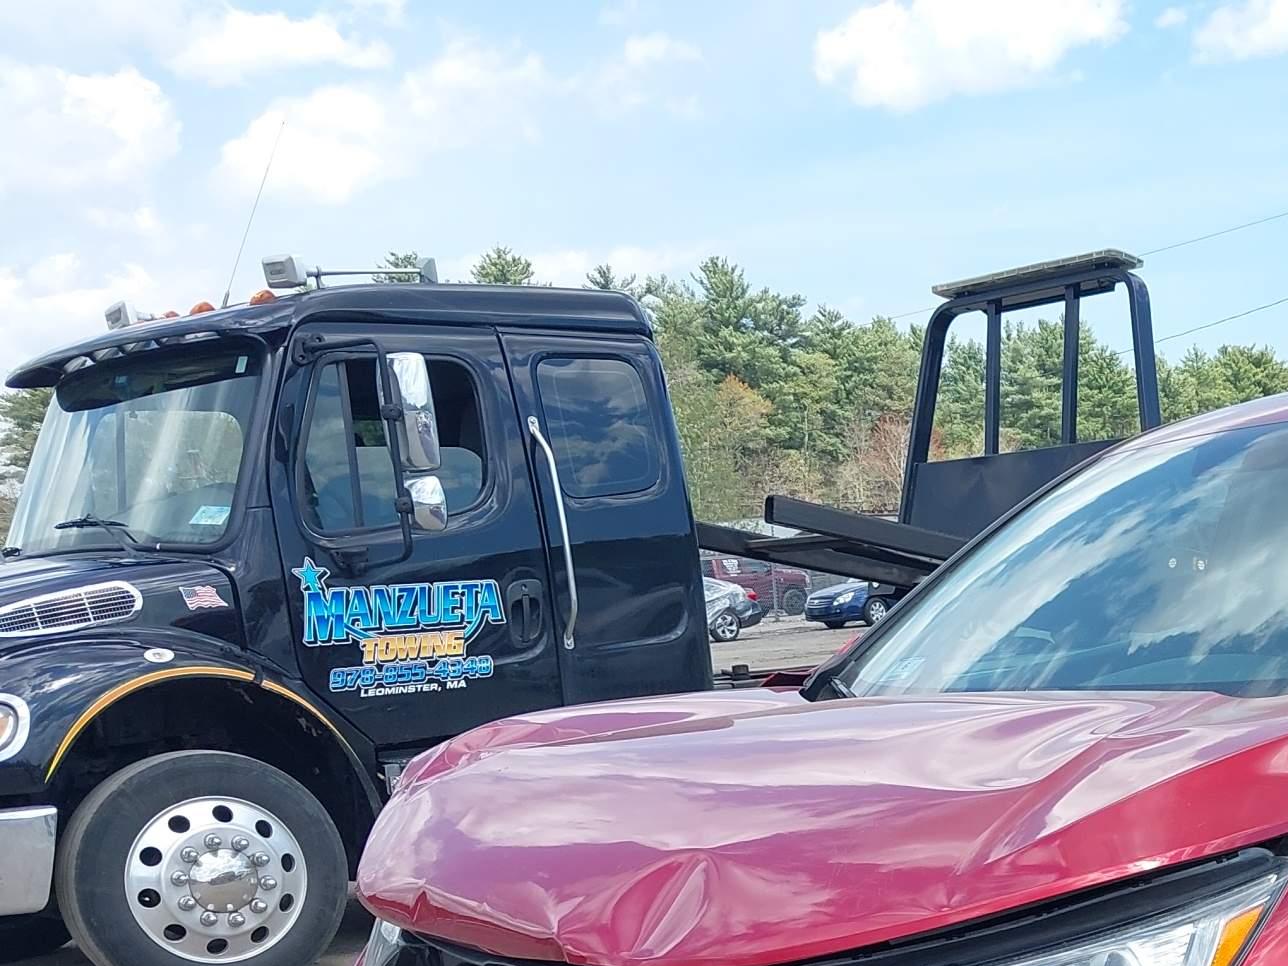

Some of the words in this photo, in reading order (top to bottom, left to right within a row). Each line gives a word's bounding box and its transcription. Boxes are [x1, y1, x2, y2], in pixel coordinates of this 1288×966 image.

[304, 580, 506, 646] MANZUETA
[361, 631, 466, 664] TOWING
[330, 656, 493, 692] 978-855-4348
[360, 683, 441, 697] LEOMINSTER,
[446, 680, 467, 689] MA
